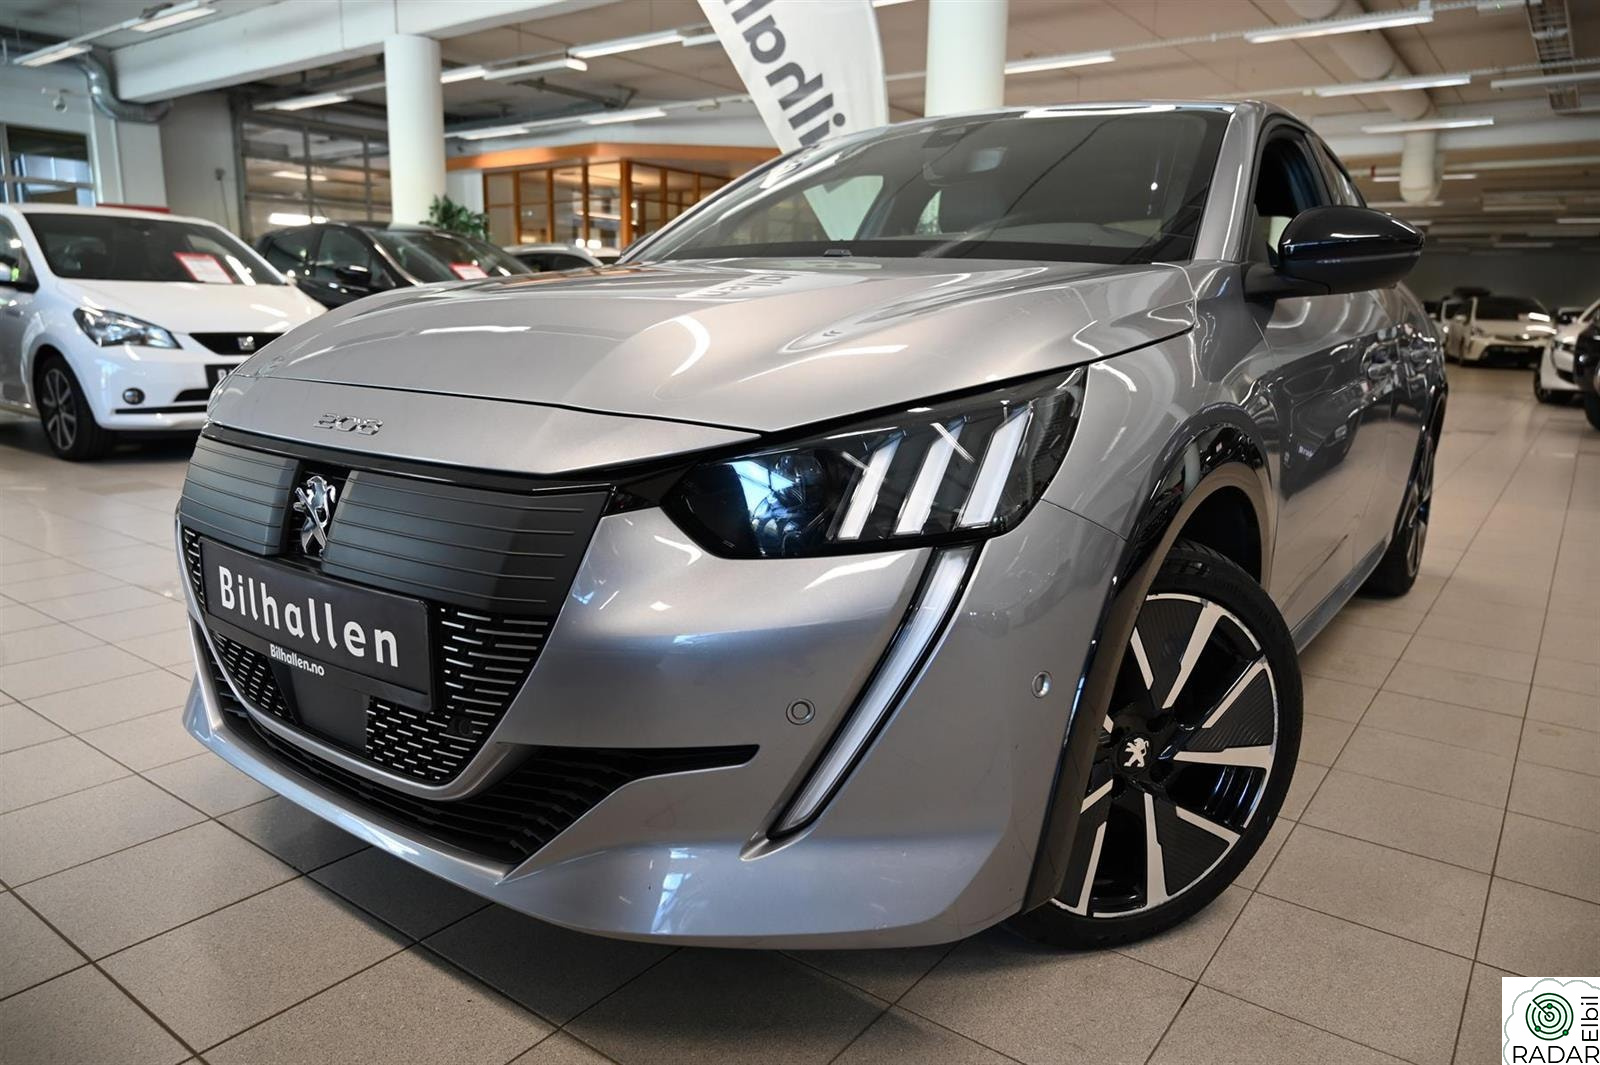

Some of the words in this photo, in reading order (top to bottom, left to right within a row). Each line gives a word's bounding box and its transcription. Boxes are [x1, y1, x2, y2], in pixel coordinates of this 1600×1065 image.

[313, 412, 384, 436] 208
[219, 566, 398, 668] Bilhallen
[270, 643, 325, 677] Bilhallen.no
